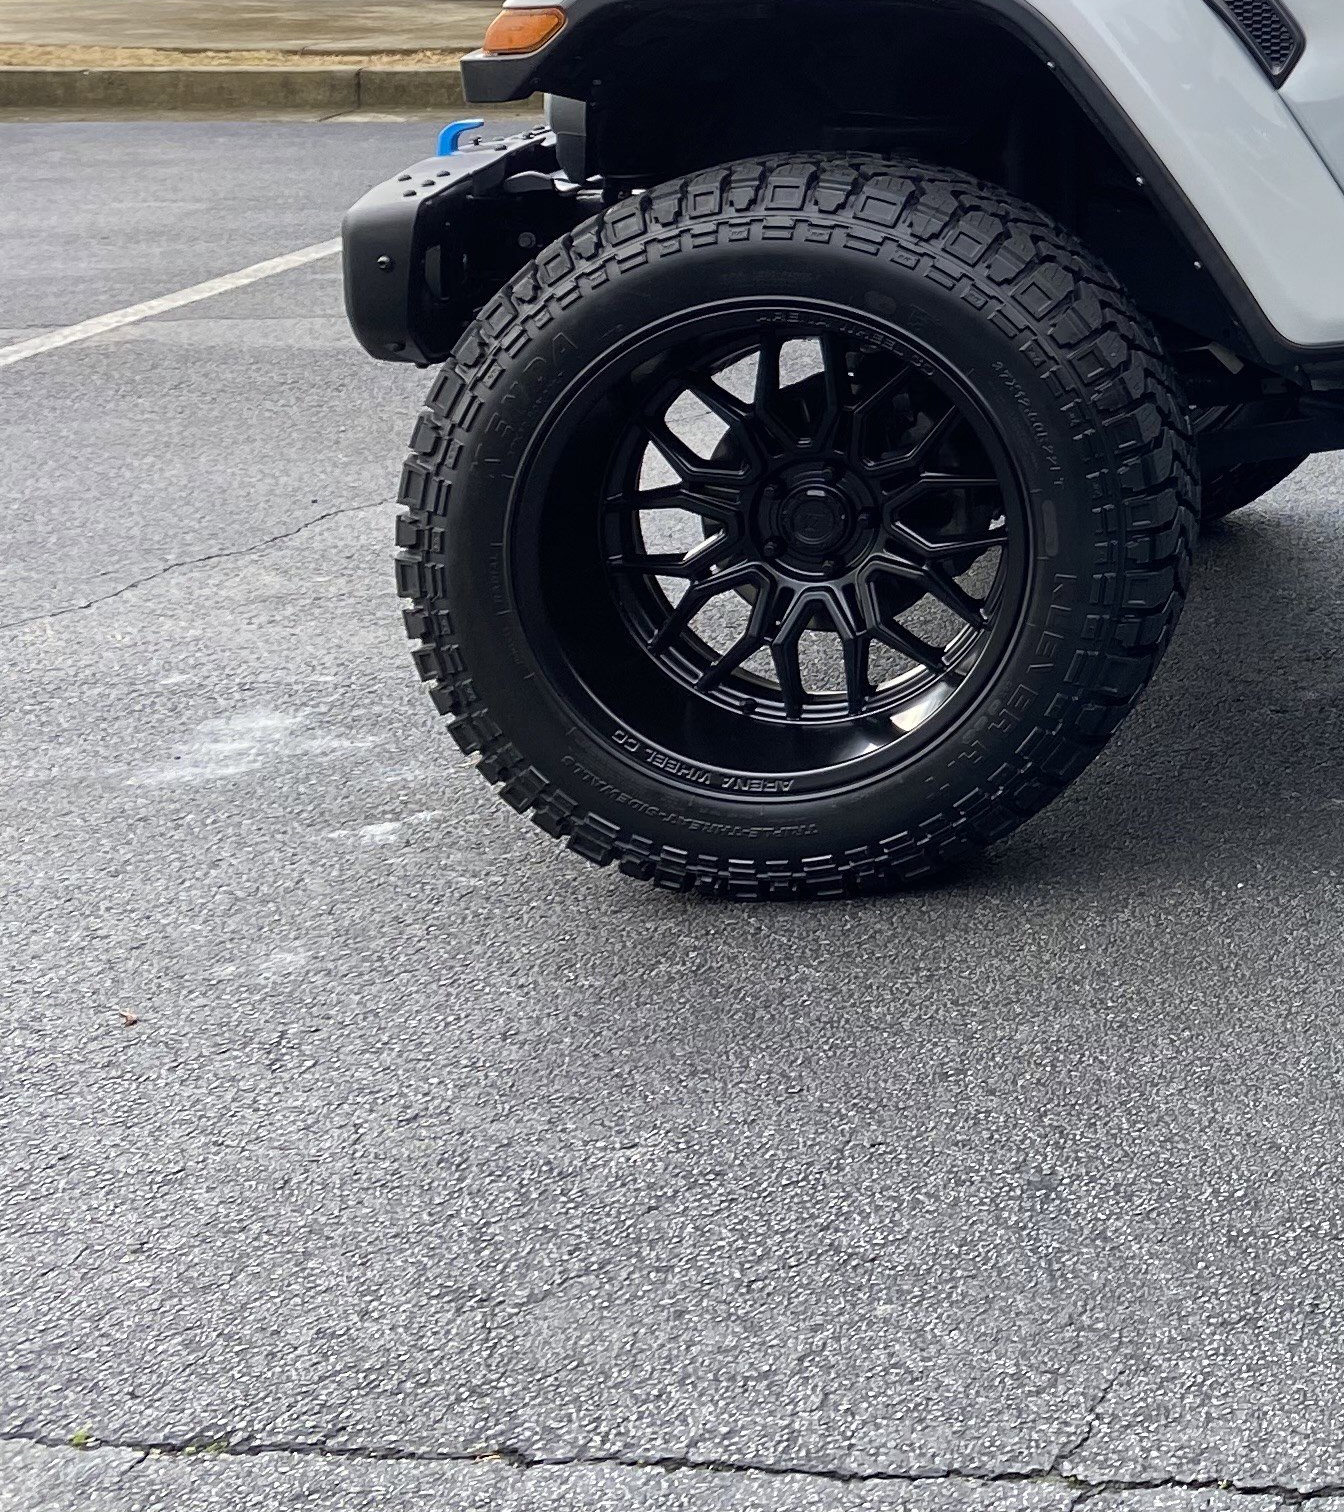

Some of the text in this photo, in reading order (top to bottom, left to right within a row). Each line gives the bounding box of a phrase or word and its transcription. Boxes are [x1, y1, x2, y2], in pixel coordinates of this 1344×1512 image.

[611, 730, 795, 792] ARENA WHEEL CO
